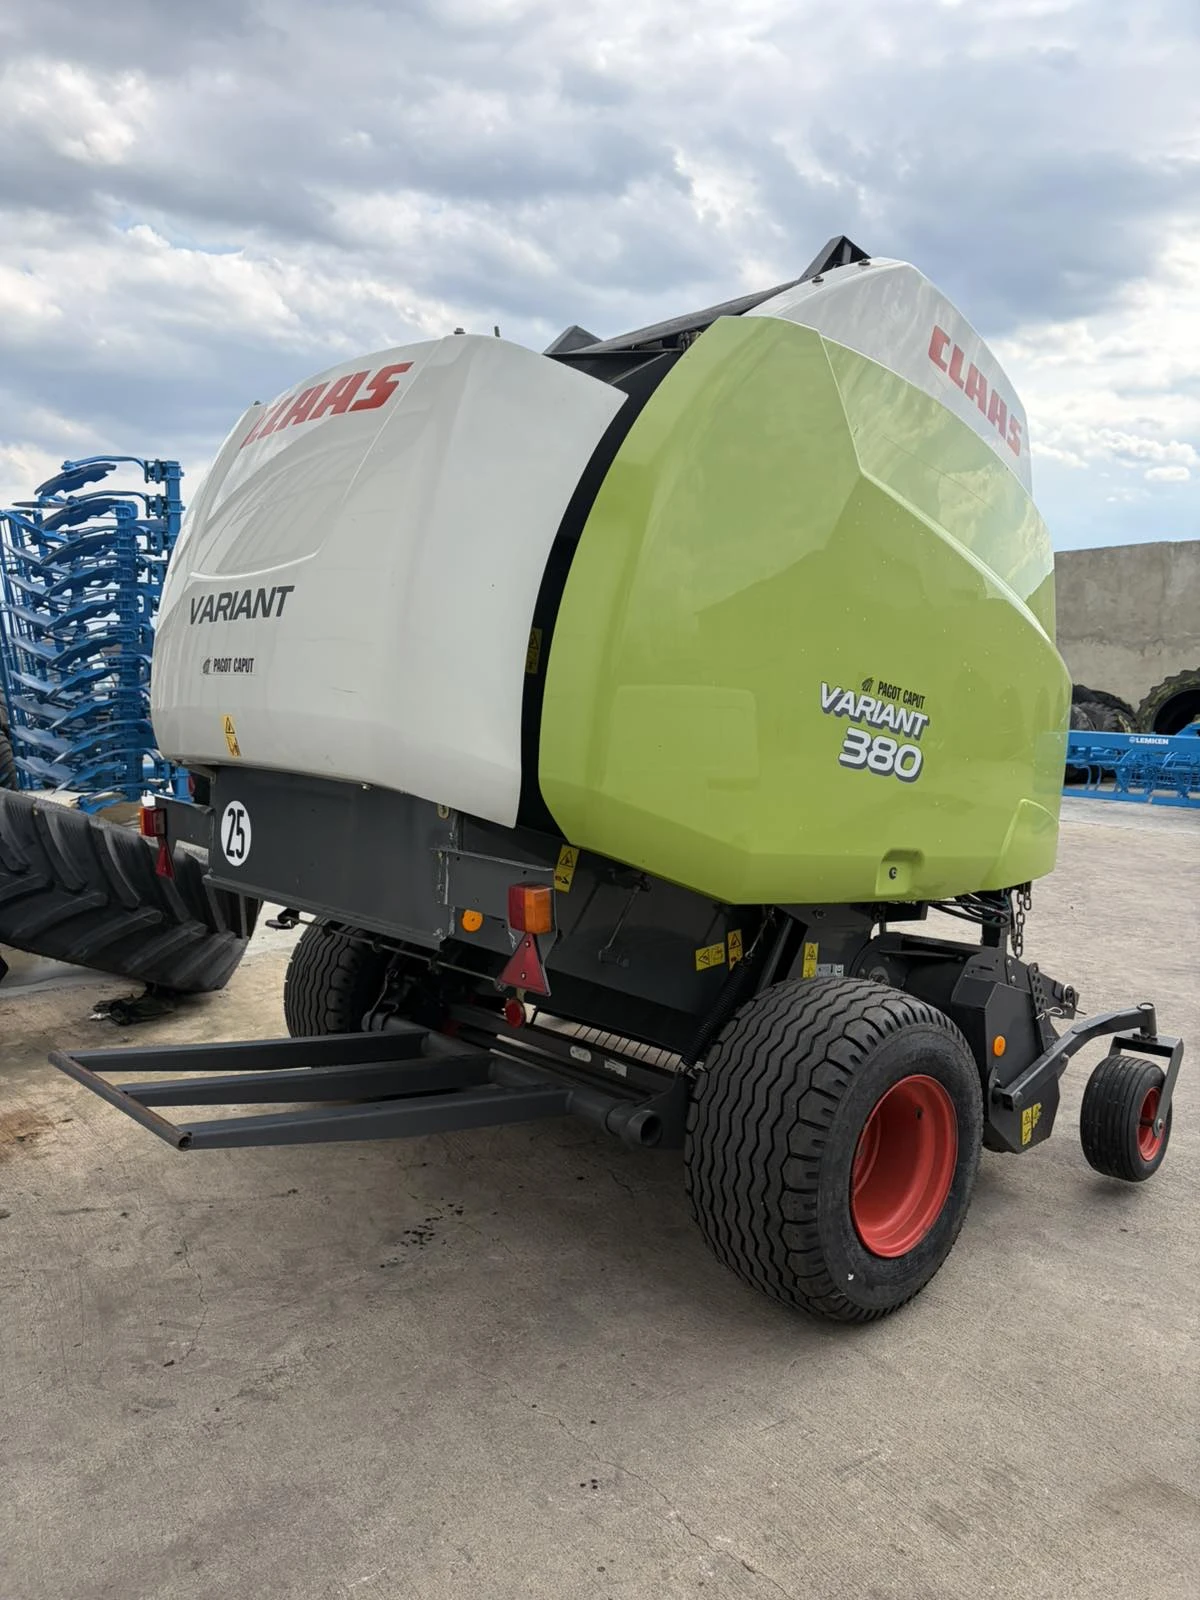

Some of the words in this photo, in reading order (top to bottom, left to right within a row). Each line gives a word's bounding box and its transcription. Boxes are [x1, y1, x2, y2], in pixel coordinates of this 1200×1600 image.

[239, 361, 415, 450] CLAAS
[928, 324, 1022, 457] CLAAS
[190, 585, 295, 625] VARIANT
[213, 658, 232, 673] PAGOT
[233, 658, 255, 673] CAPUT
[820, 681, 930, 741] VARIANT
[877, 681, 902, 701] PAGOT
[903, 690, 926, 709] CAPUT
[838, 726, 924, 783] 380
[1135, 737, 1169, 745] LEMKEN
[226, 807, 245, 859] 25
